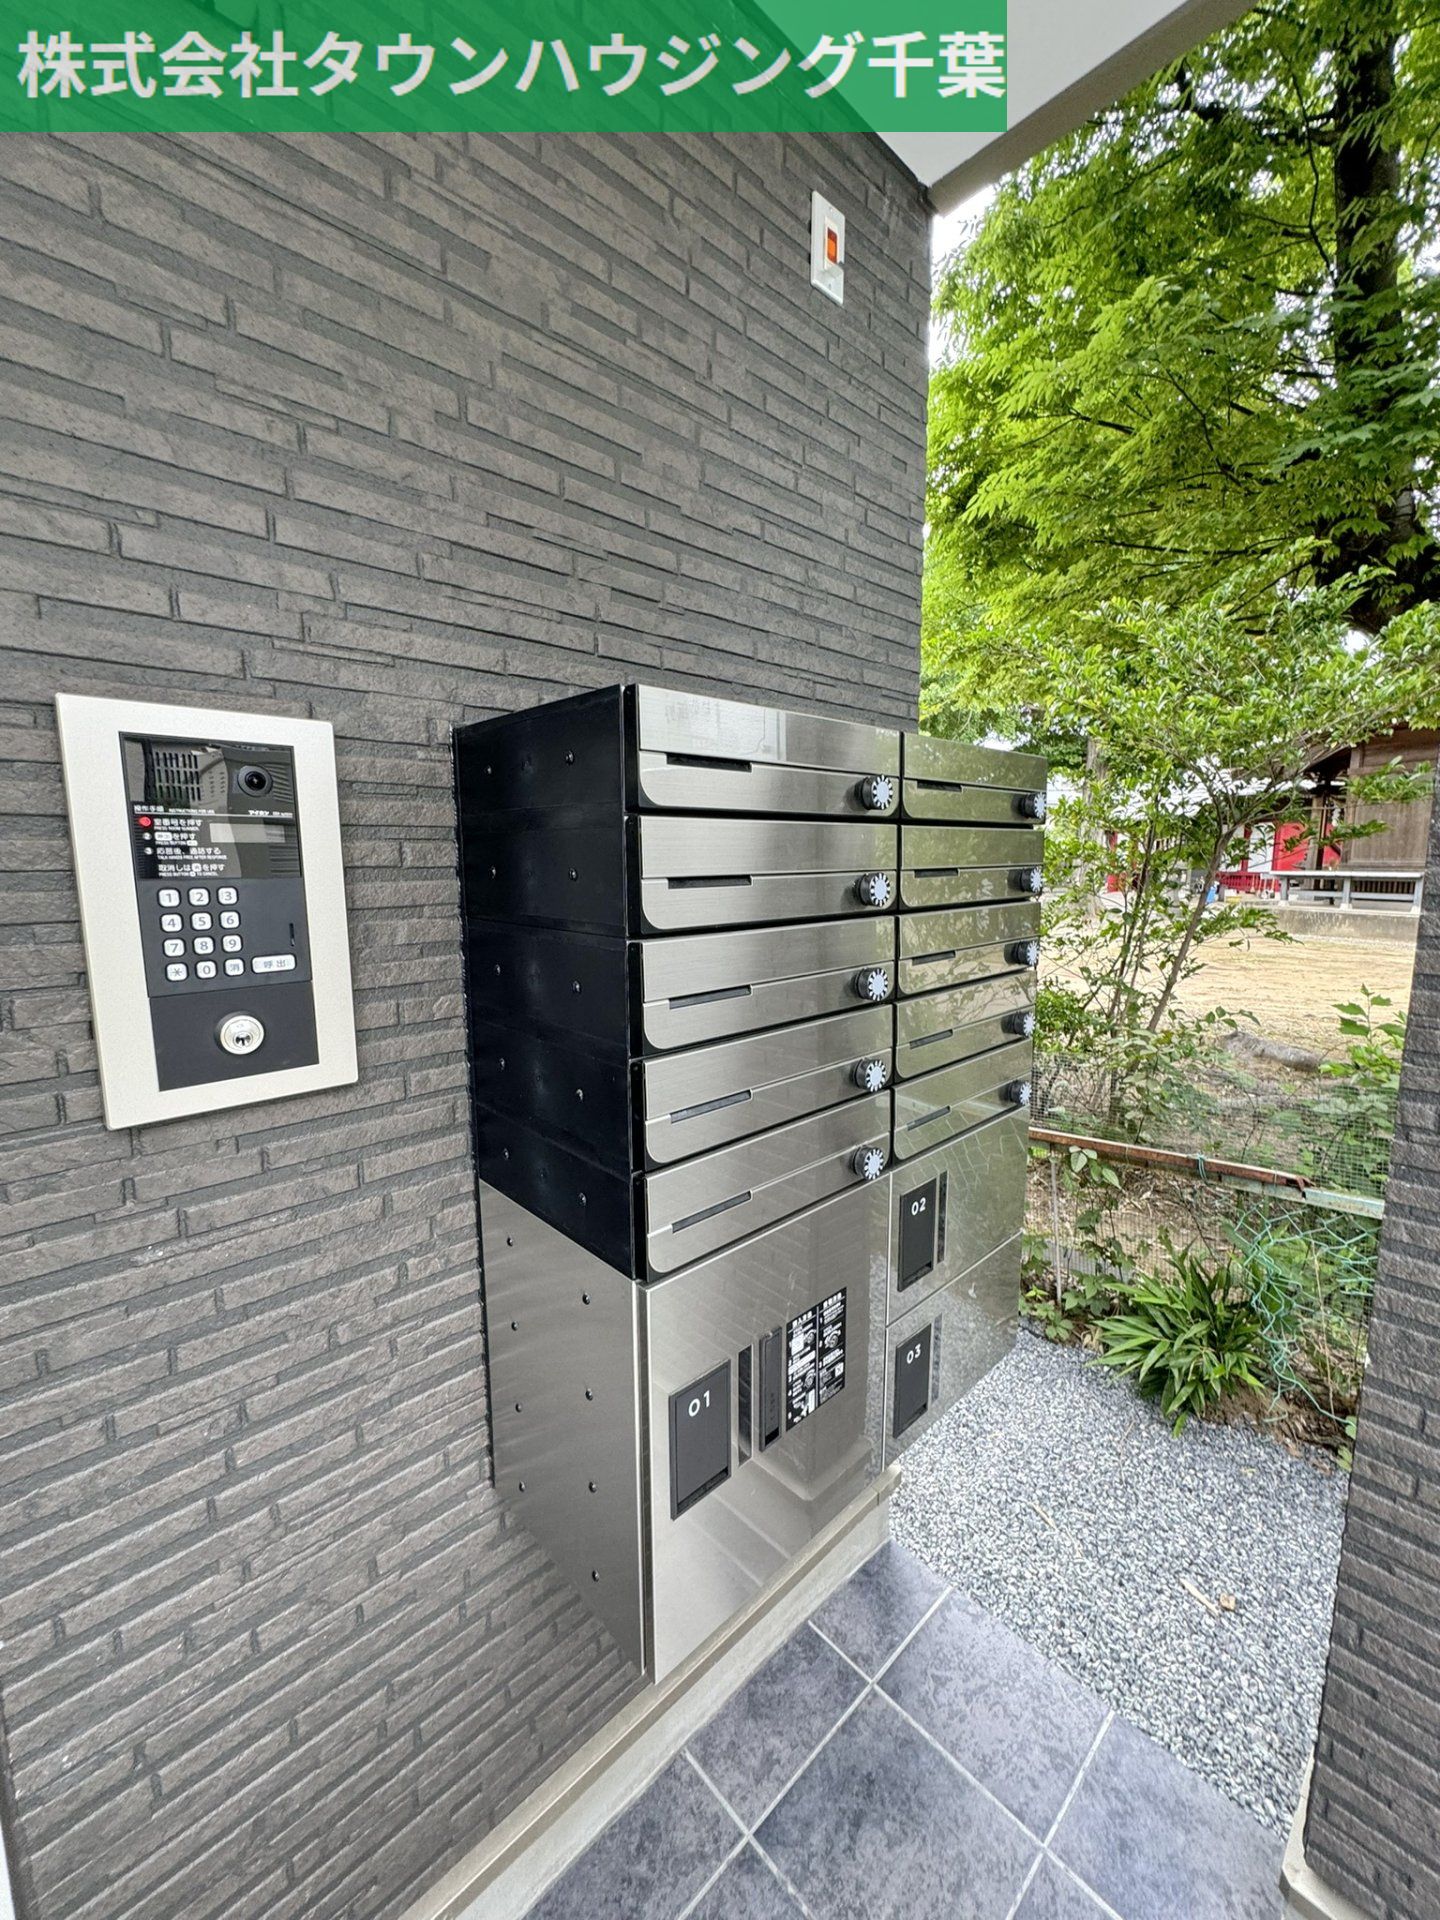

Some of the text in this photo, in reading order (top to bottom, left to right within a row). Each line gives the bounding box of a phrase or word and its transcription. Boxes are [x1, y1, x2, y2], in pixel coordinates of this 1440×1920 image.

[165, 891, 232, 903] 1 2 3
[167, 915, 234, 928] 4 5 6
[169, 939, 237, 953] 7 8 9
[203, 966, 211, 975] 0
[911, 1197, 926, 1216] 02
[906, 1343, 921, 1364] 03
[688, 1389, 711, 1417] 01
